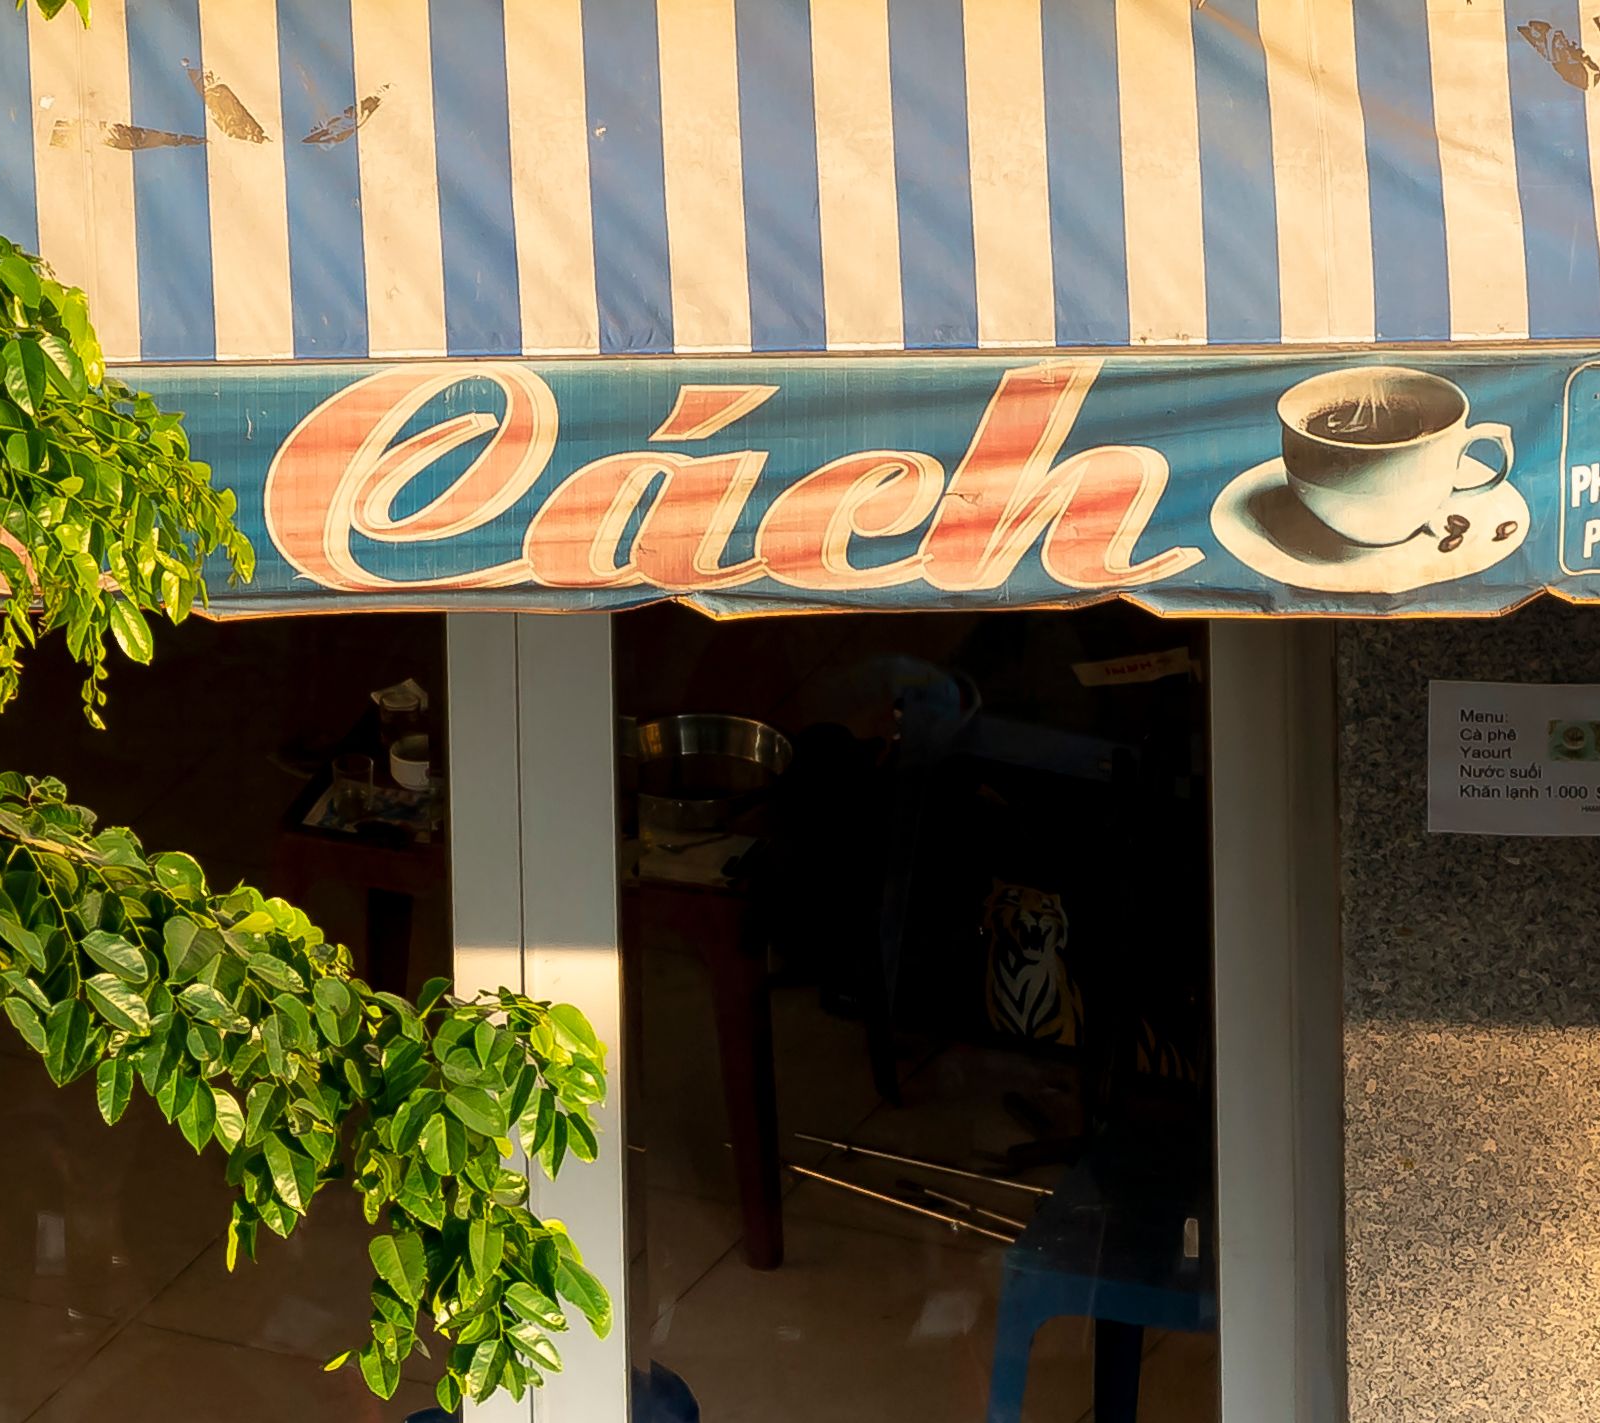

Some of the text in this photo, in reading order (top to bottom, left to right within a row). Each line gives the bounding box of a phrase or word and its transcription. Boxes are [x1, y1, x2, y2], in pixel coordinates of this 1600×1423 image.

[265, 358, 1206, 592] Cách
[1460, 709, 1509, 724] Menu:
[1460, 728, 1517, 744] Cà phê
[1461, 746, 1512, 760] Yaourt
[1460, 763, 1542, 779] Nước suối
[1460, 785, 1501, 799] Khăn
[1506, 785, 1539, 801] lạnh
[1545, 786, 1588, 799] 1.000
